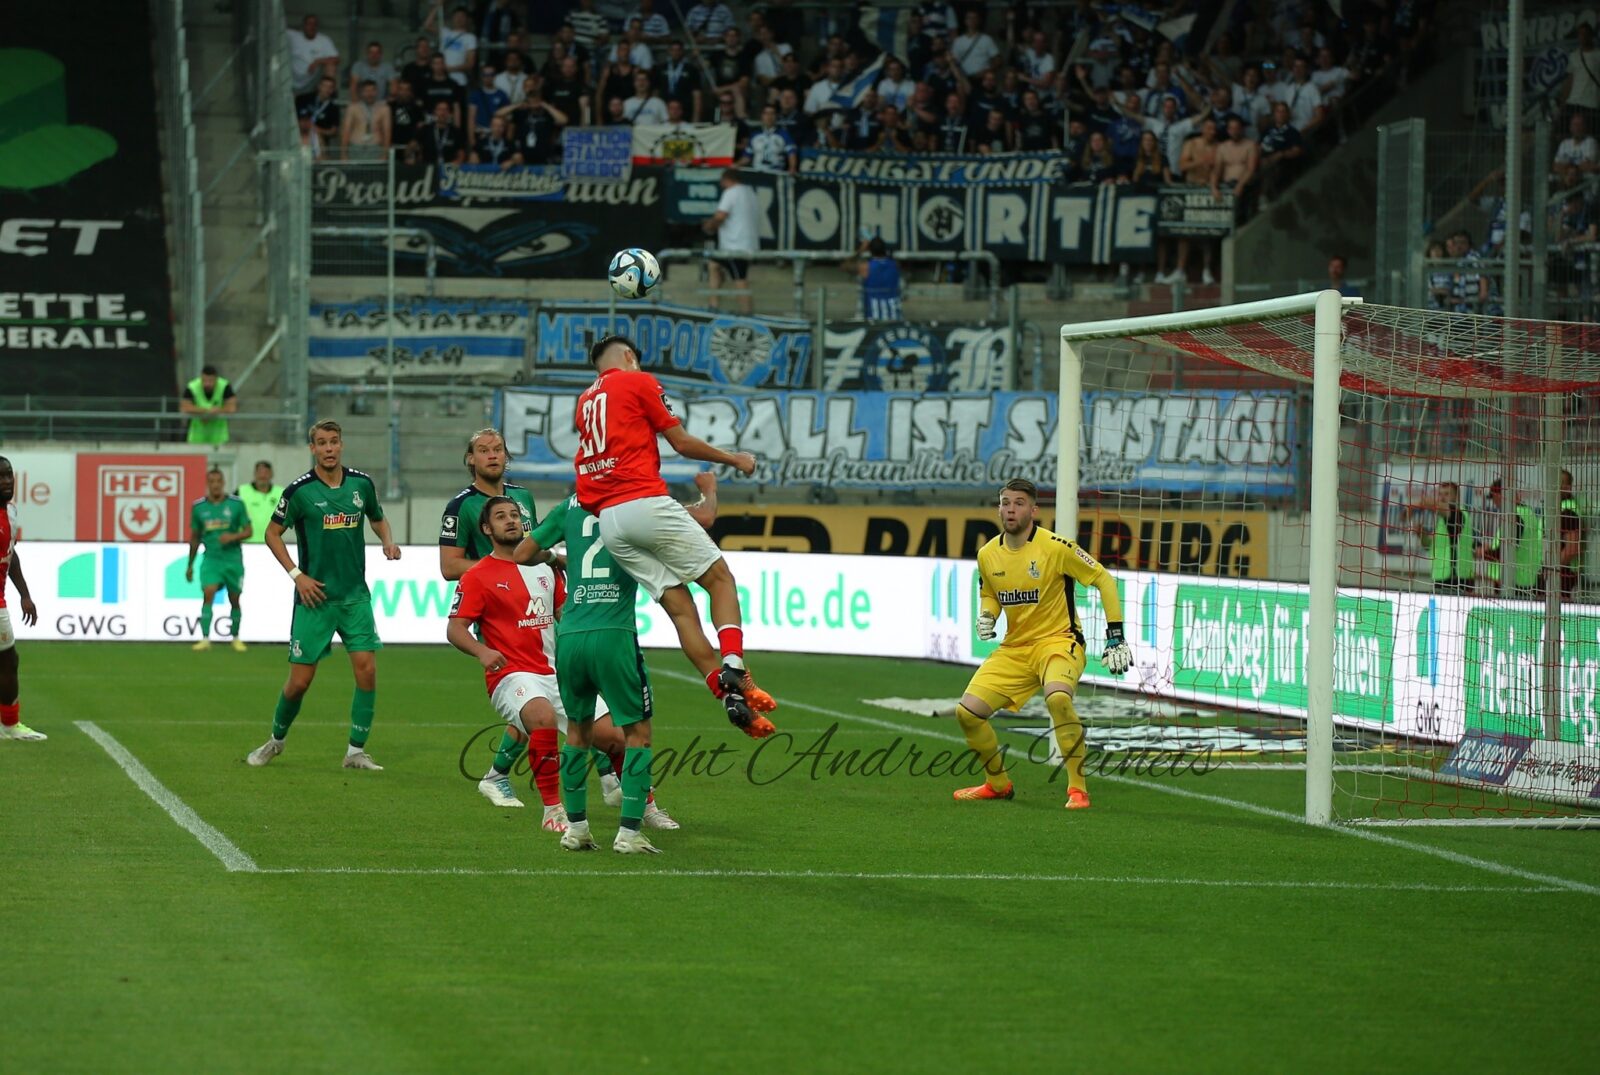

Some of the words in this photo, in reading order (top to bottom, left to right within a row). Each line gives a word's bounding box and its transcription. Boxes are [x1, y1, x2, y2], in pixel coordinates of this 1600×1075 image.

[583, 392, 607, 458] 20
[887, 398, 992, 462] IST
[106, 471, 176, 493] HFC
[582, 516, 611, 579] 2
[998, 588, 1040, 603] trinkgut
[57, 614, 127, 636] GWG
